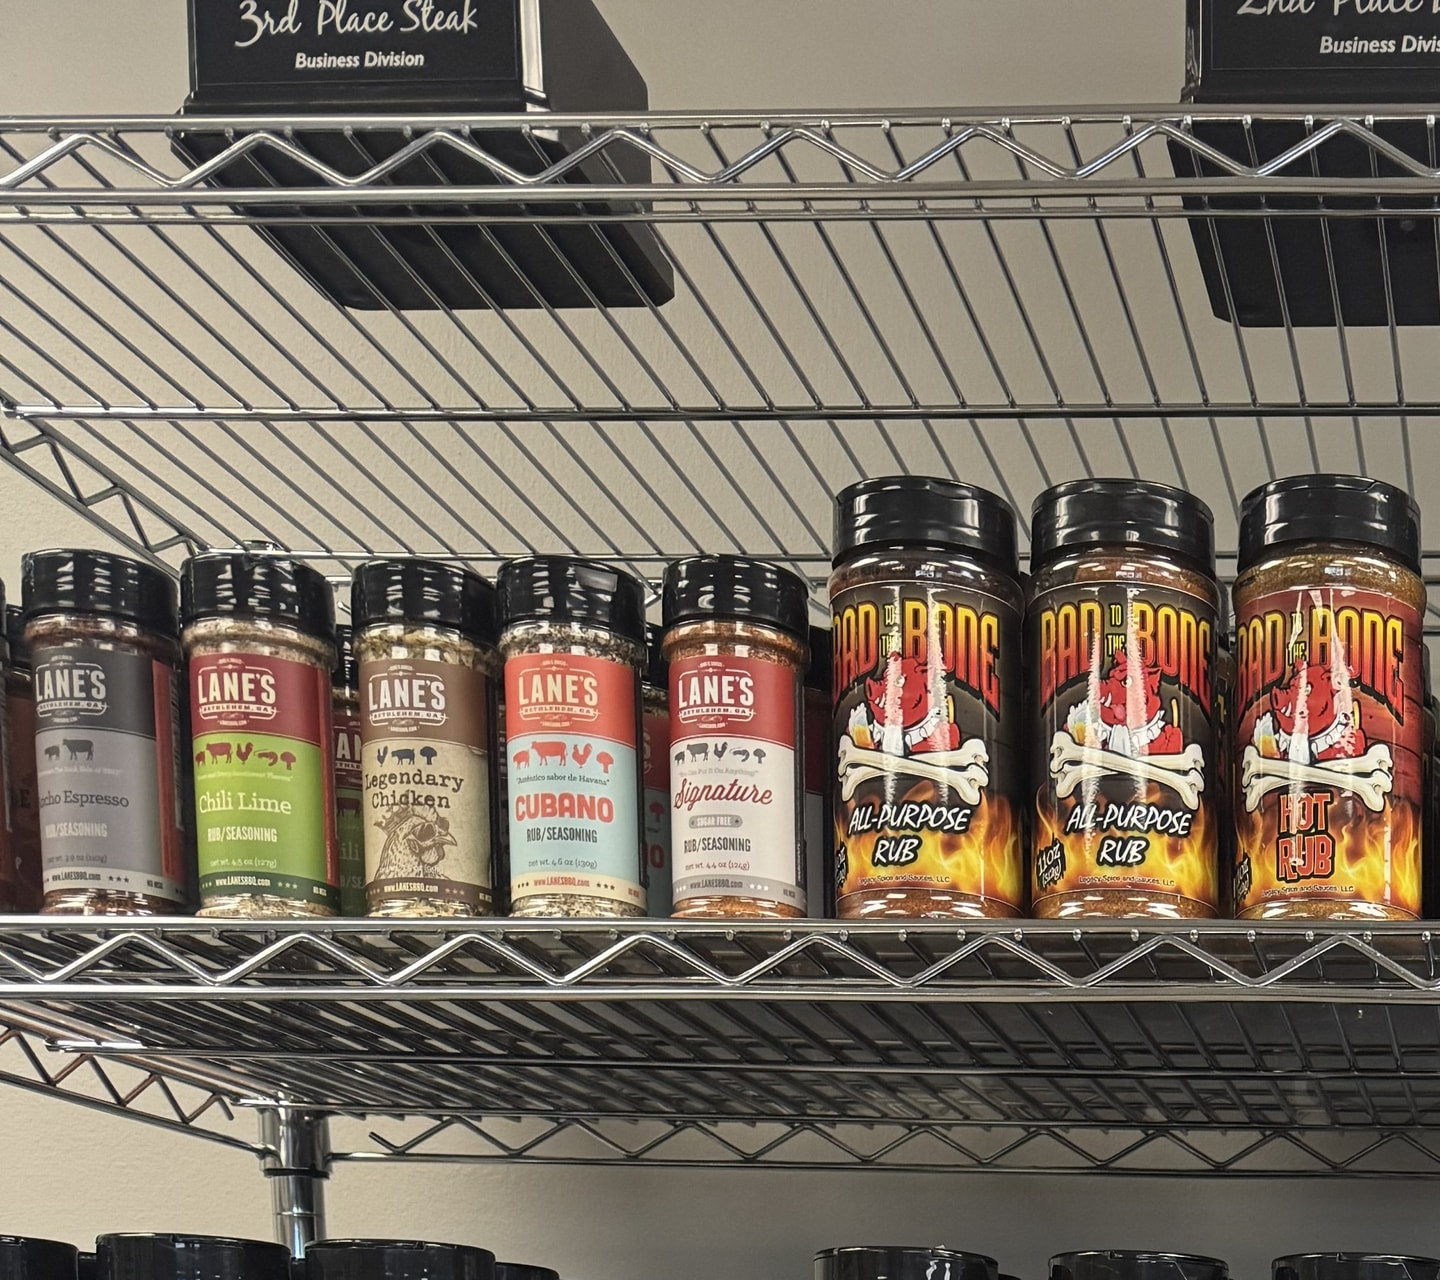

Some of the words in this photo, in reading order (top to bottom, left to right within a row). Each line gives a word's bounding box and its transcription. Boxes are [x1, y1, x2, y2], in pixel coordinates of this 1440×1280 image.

[317, 0, 394, 34] Place
[398, 0, 478, 34] Steak
[294, 51, 360, 69] Business
[364, 51, 424, 68] Division
[1319, 36, 1396, 54] Business
[35, 669, 107, 703] LANE'S
[368, 679, 446, 712] LANE'S
[517, 674, 599, 707] LANE'S
[365, 769, 464, 793] Legendary
[673, 777, 773, 812] Signature
[63, 790, 129, 808] Espresso
[198, 790, 234, 814] Chili
[237, 792, 292, 816] Lime
[371, 789, 451, 810] Chicken
[515, 791, 614, 824] CUBANO
[1280, 793, 1331, 832] HOT
[848, 802, 972, 833] ALL-PURPOSE
[207, 826, 278, 844] RUB/SEASONING
[873, 839, 918, 864] RUB
[1278, 834, 1333, 879] RUB
